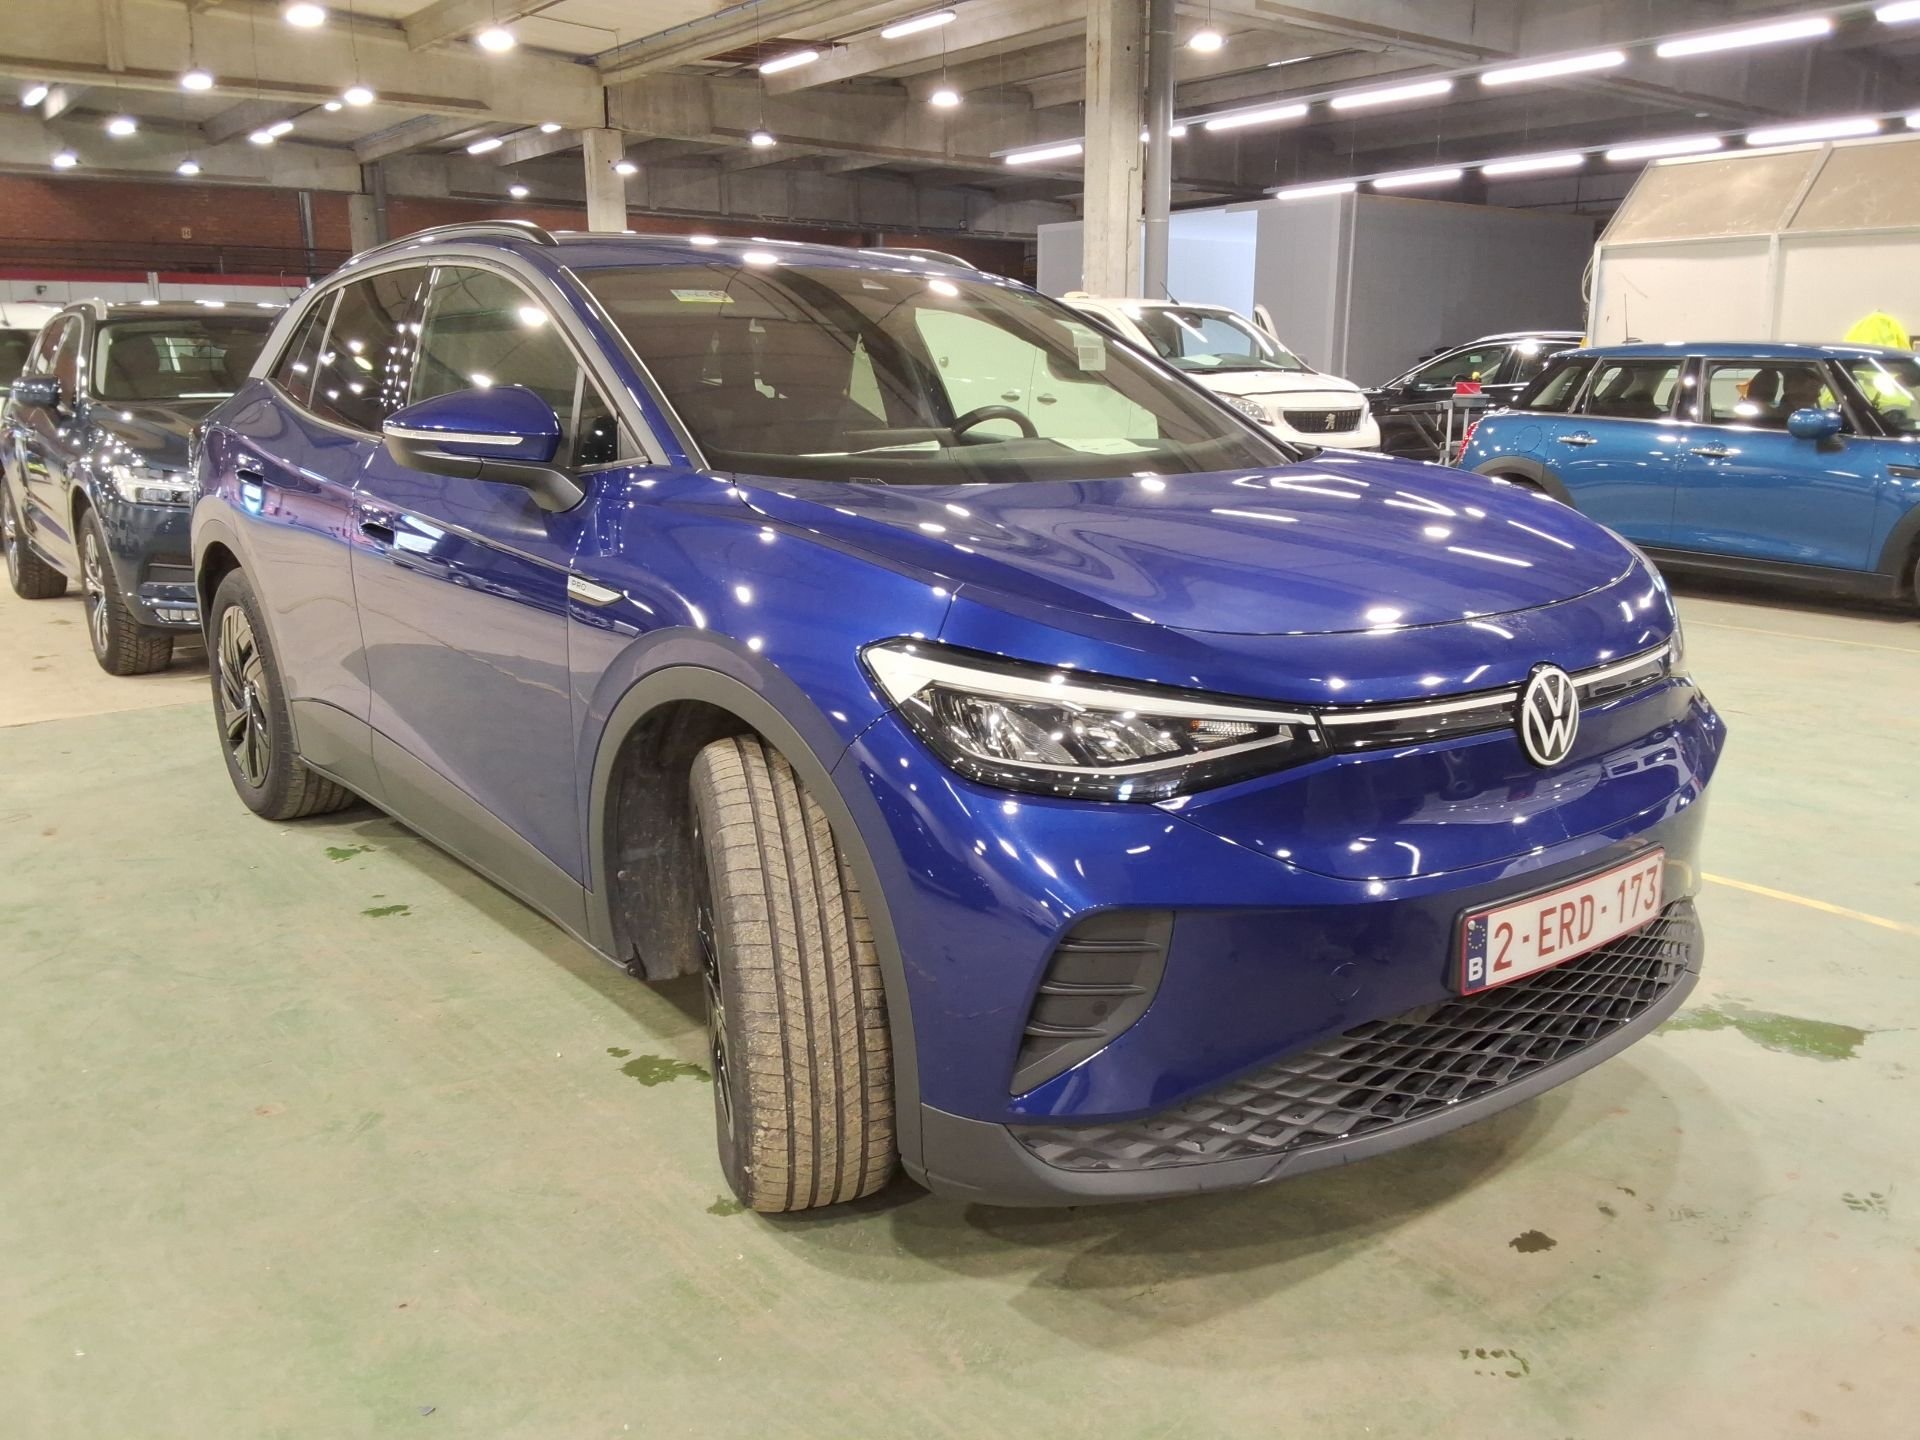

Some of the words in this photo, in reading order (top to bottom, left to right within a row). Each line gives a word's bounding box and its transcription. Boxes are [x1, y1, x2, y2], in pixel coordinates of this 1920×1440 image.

[572, 580, 587, 591] PRO
[1524, 668, 1579, 765] VW
[1493, 865, 1659, 972] 2-ERD-173
[1468, 956, 1483, 981] B
